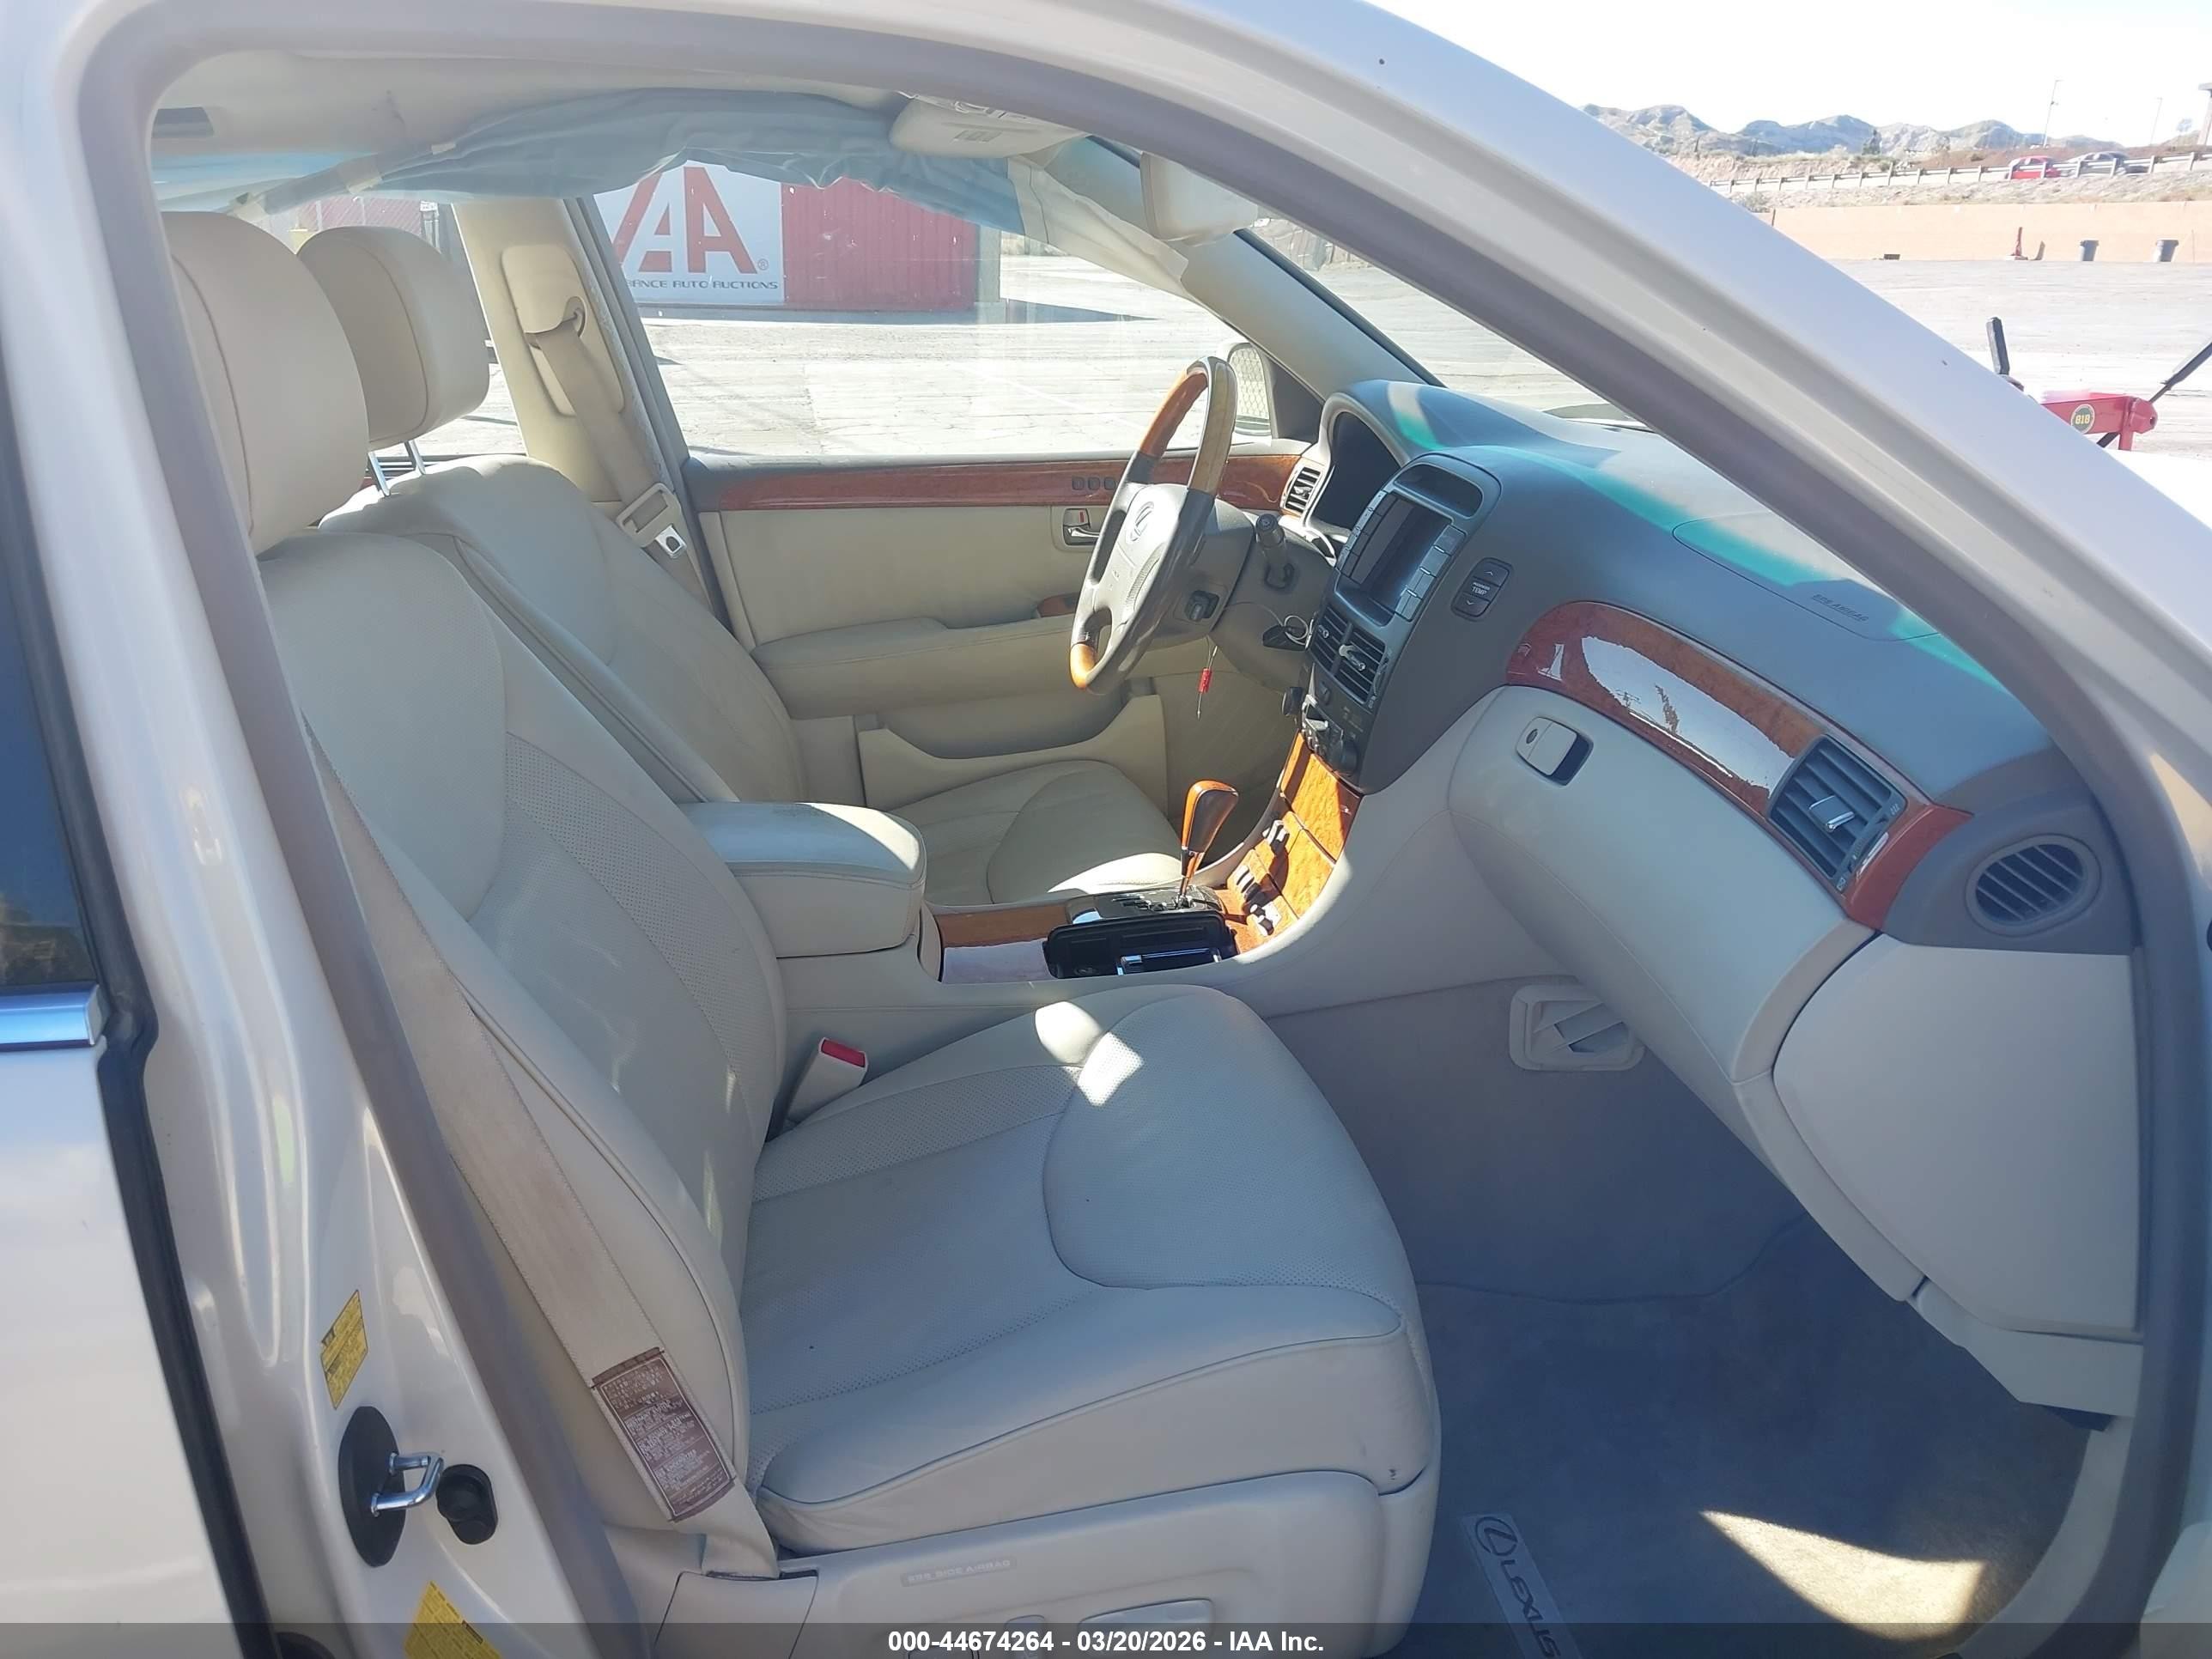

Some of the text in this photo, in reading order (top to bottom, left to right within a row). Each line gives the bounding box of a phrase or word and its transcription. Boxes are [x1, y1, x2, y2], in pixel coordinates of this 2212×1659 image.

[673, 280, 709, 289] AUTO
[713, 281, 779, 289] AUCTIONS
[1500, 1559, 1561, 1658] LEXUS
